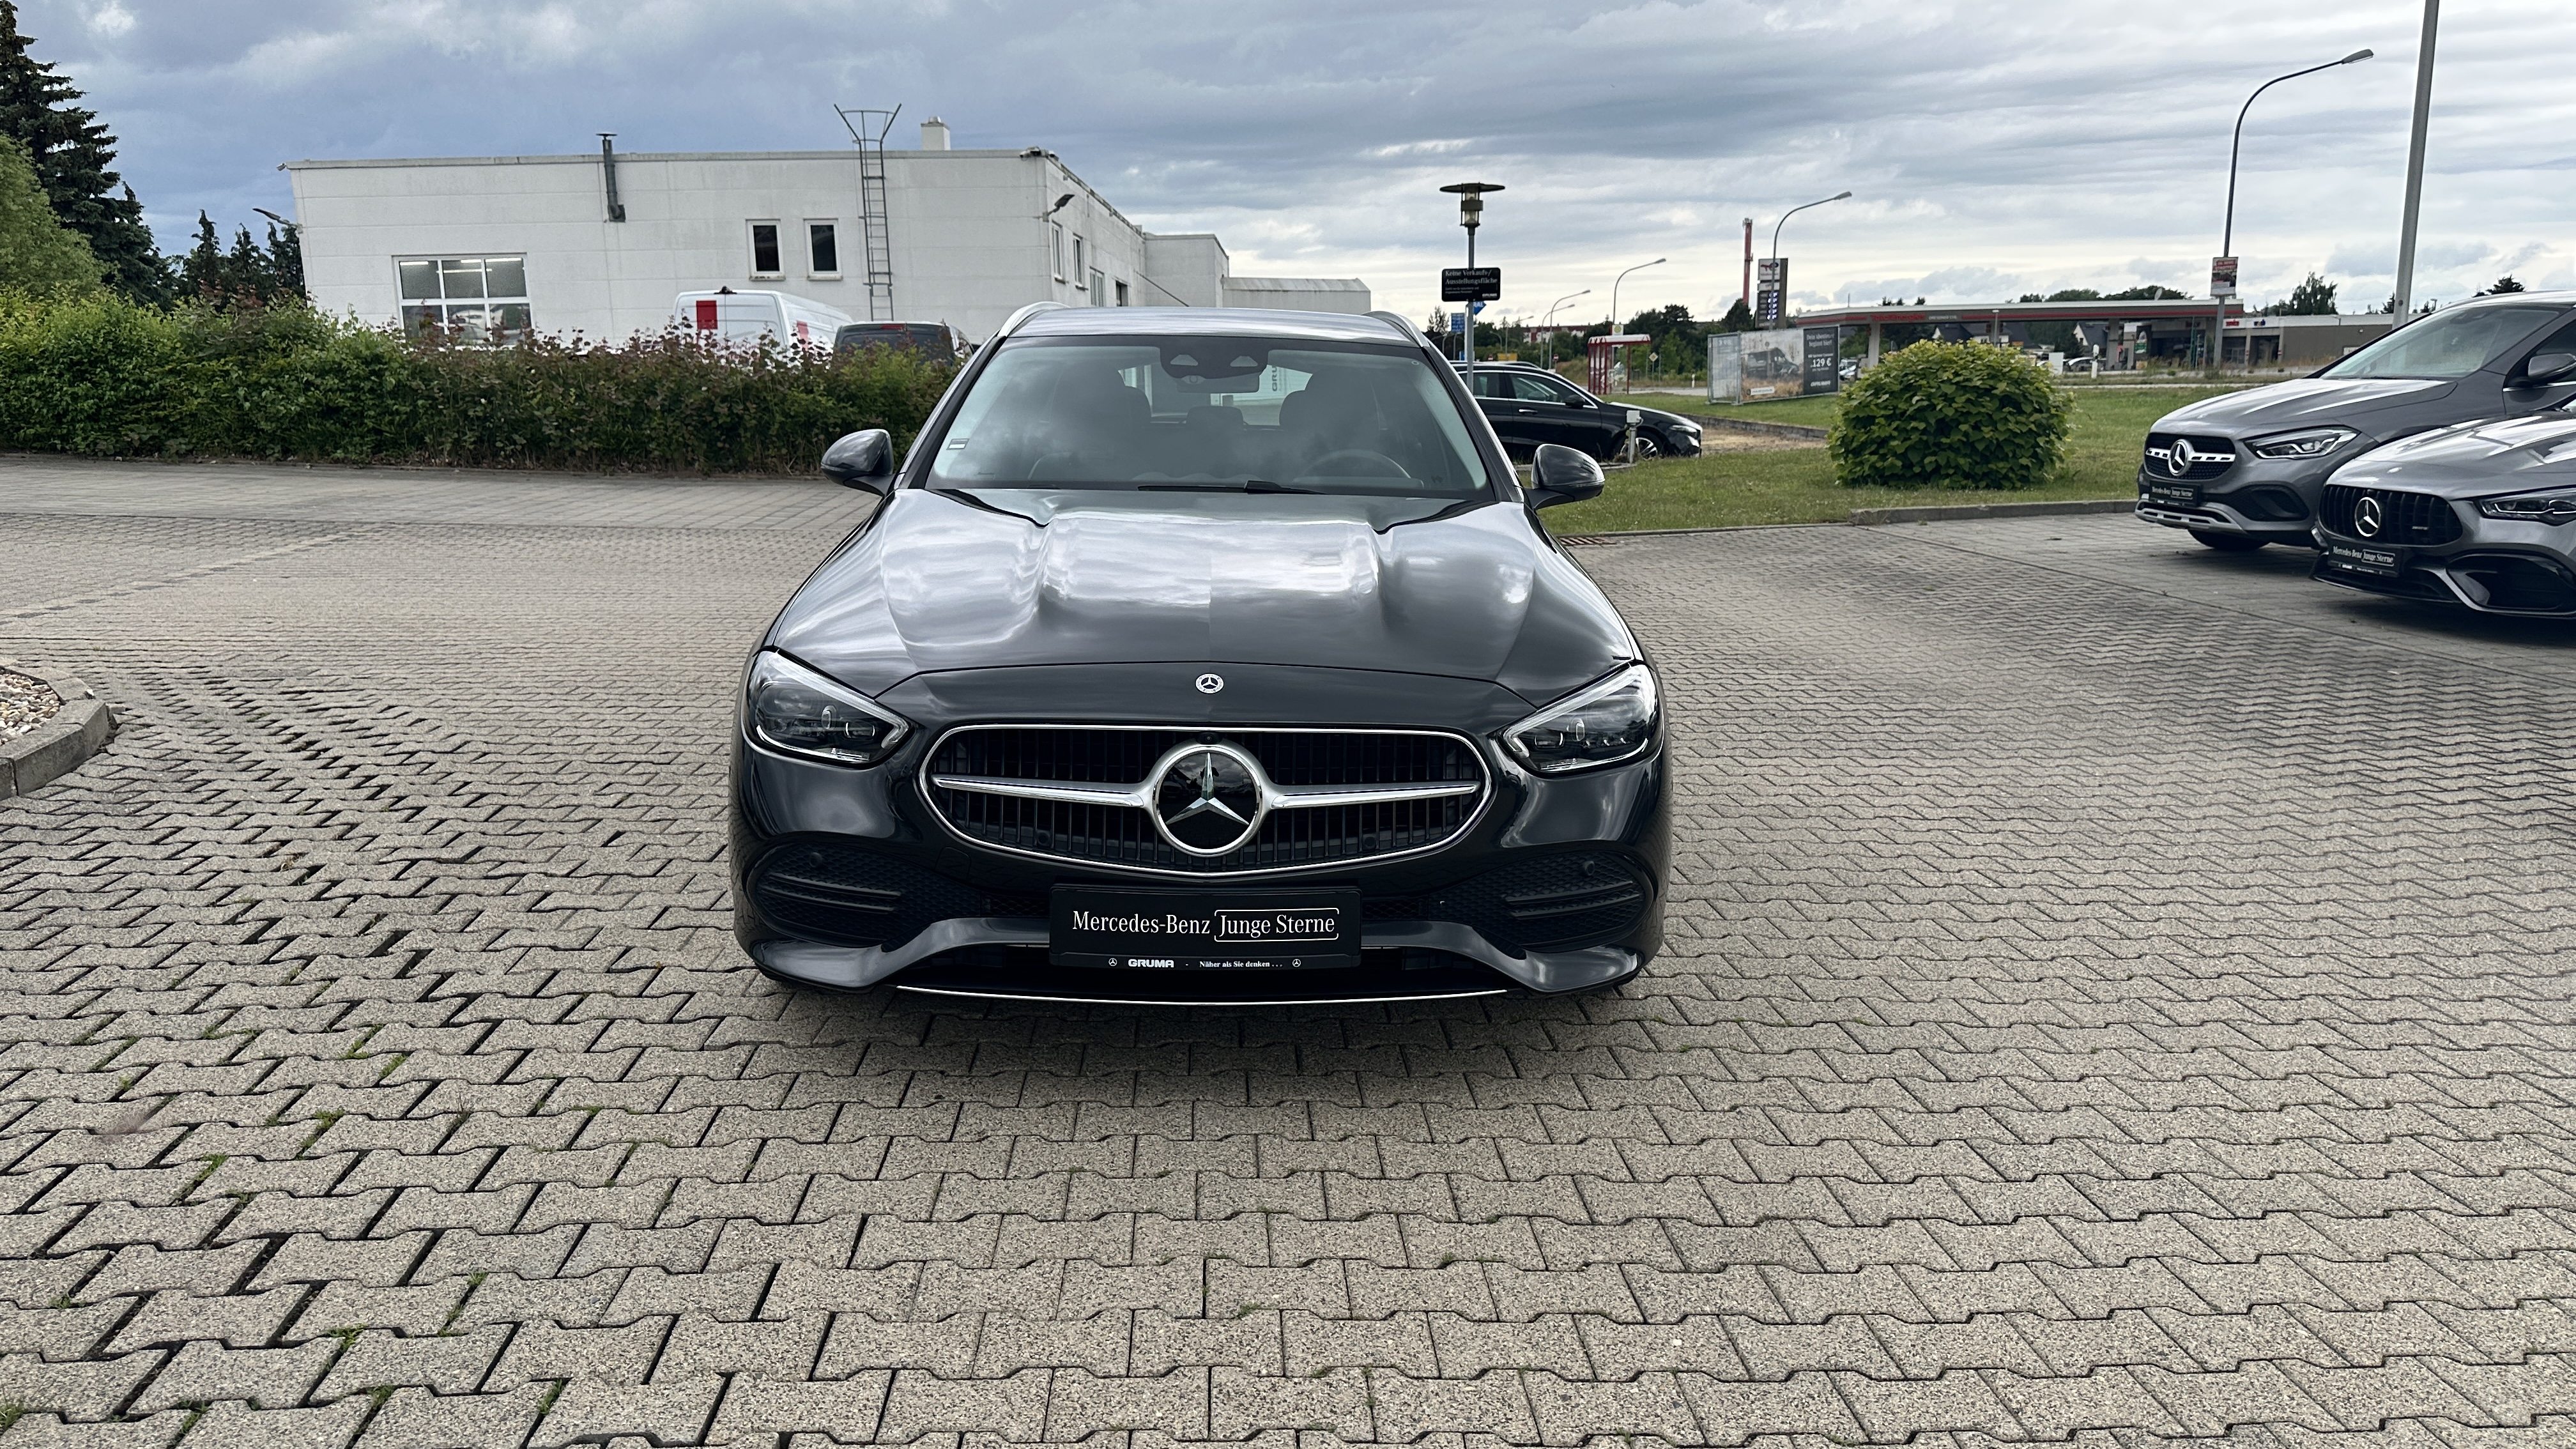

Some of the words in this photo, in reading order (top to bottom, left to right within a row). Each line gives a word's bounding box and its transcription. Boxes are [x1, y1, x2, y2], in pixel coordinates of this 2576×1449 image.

[1813, 358, 1825, 367] 129
[2333, 546, 2363, 559] Mercedes-Benz
[2377, 553, 2394, 563] Sterne
[1072, 910, 1211, 935] Mercedes-Benz
[1218, 914, 1271, 939] Junge
[1275, 914, 1335, 934] Sterne
[1128, 958, 1174, 968] GRUMA
